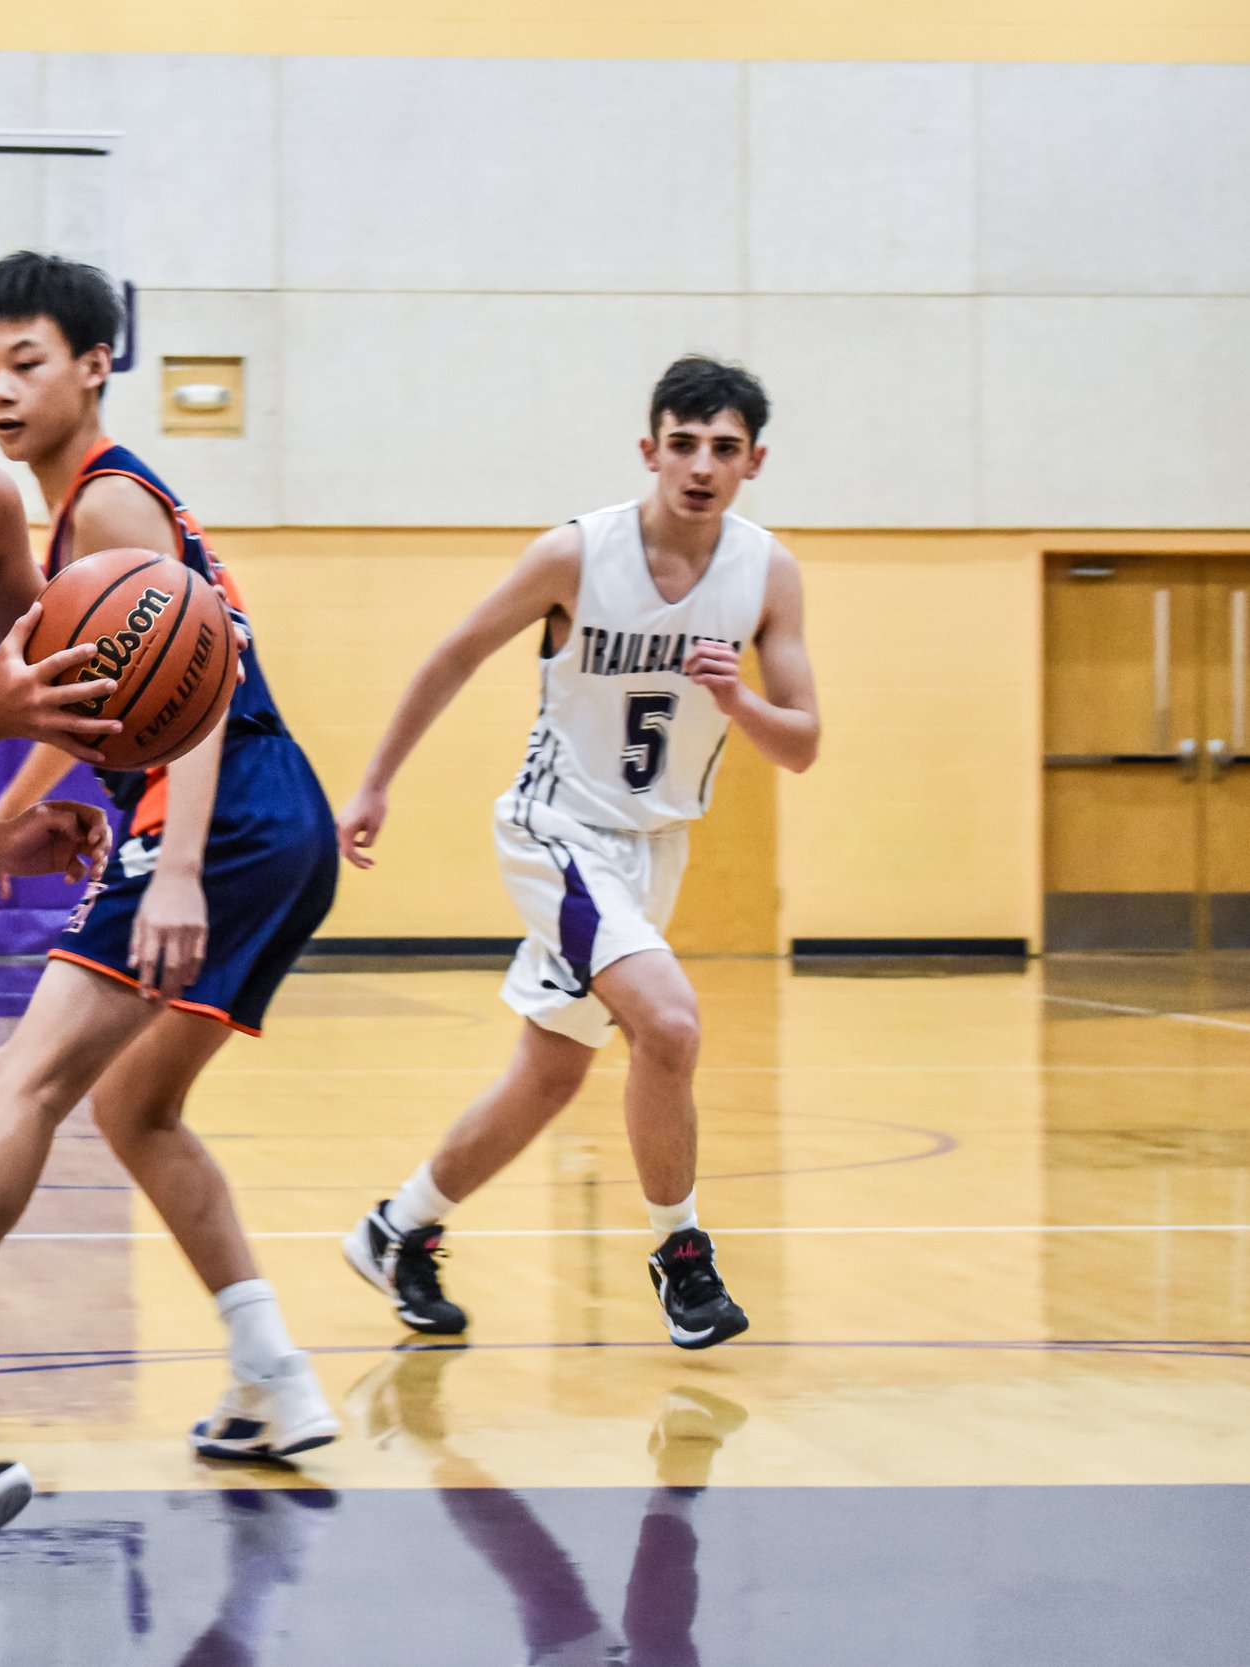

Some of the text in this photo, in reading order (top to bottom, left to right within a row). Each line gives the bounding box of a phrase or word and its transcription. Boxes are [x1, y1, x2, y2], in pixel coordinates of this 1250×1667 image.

[134, 623, 217, 747] EVOLUTION
[581, 626, 741, 677] TRAILBLA
[621, 691, 678, 794] 5
